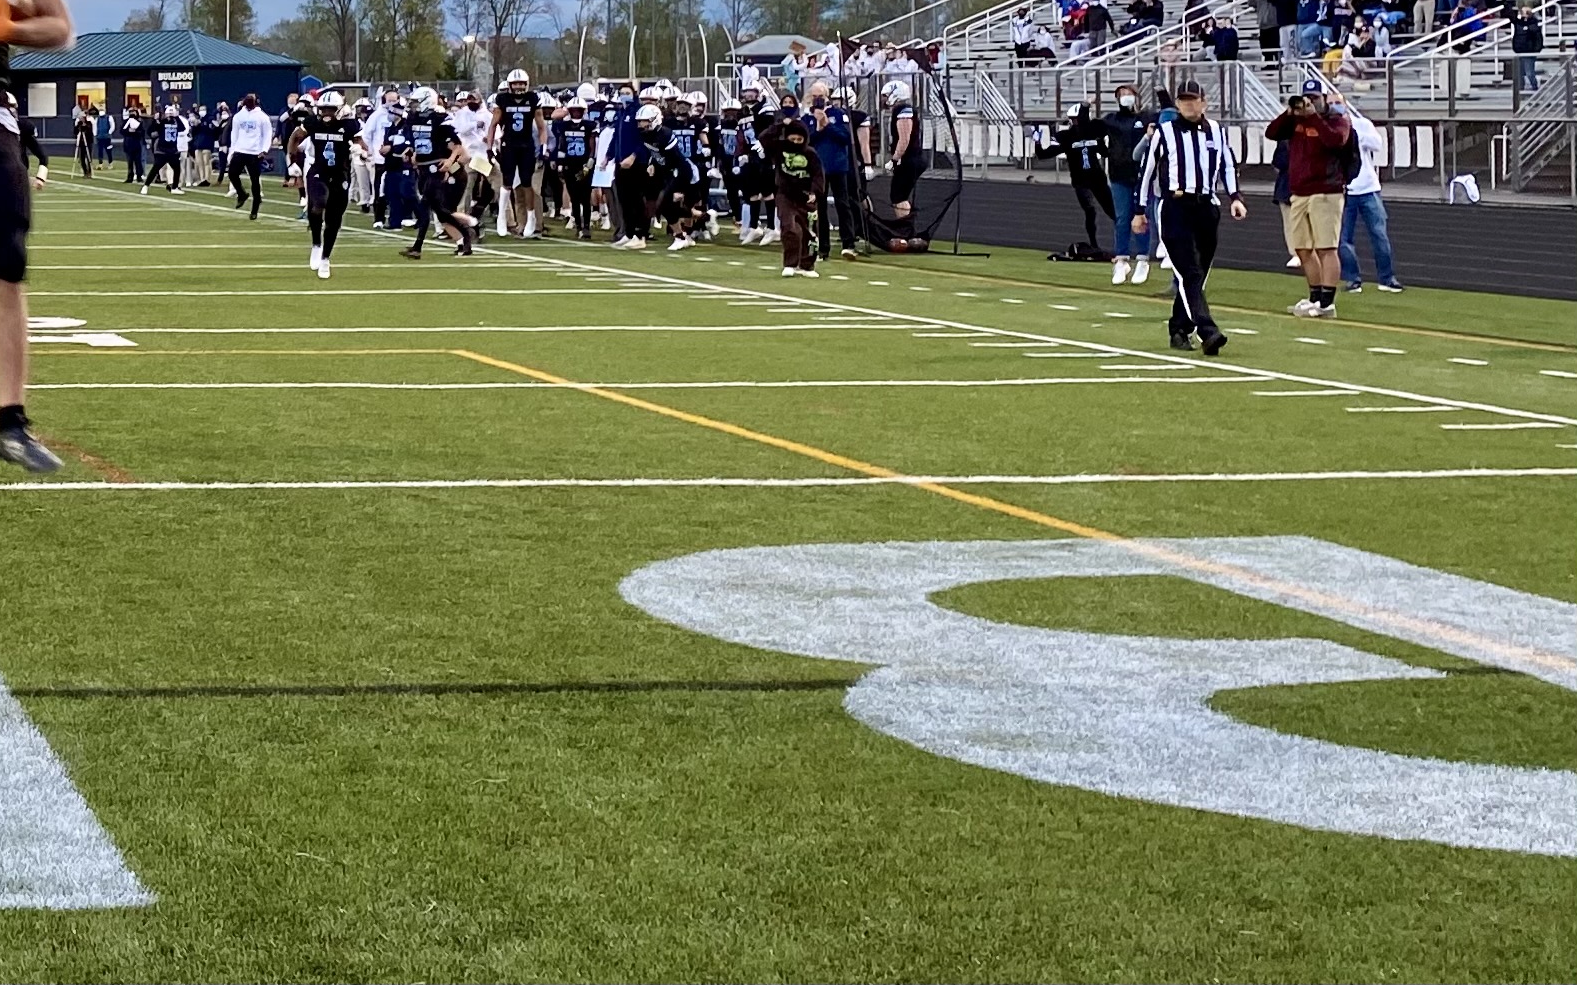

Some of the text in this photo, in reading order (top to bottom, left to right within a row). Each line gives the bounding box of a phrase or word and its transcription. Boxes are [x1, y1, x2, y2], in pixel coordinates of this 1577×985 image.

[158, 72, 194, 81] BULLDOG
[170, 81, 193, 90] BITES
[512, 112, 524, 132] 3
